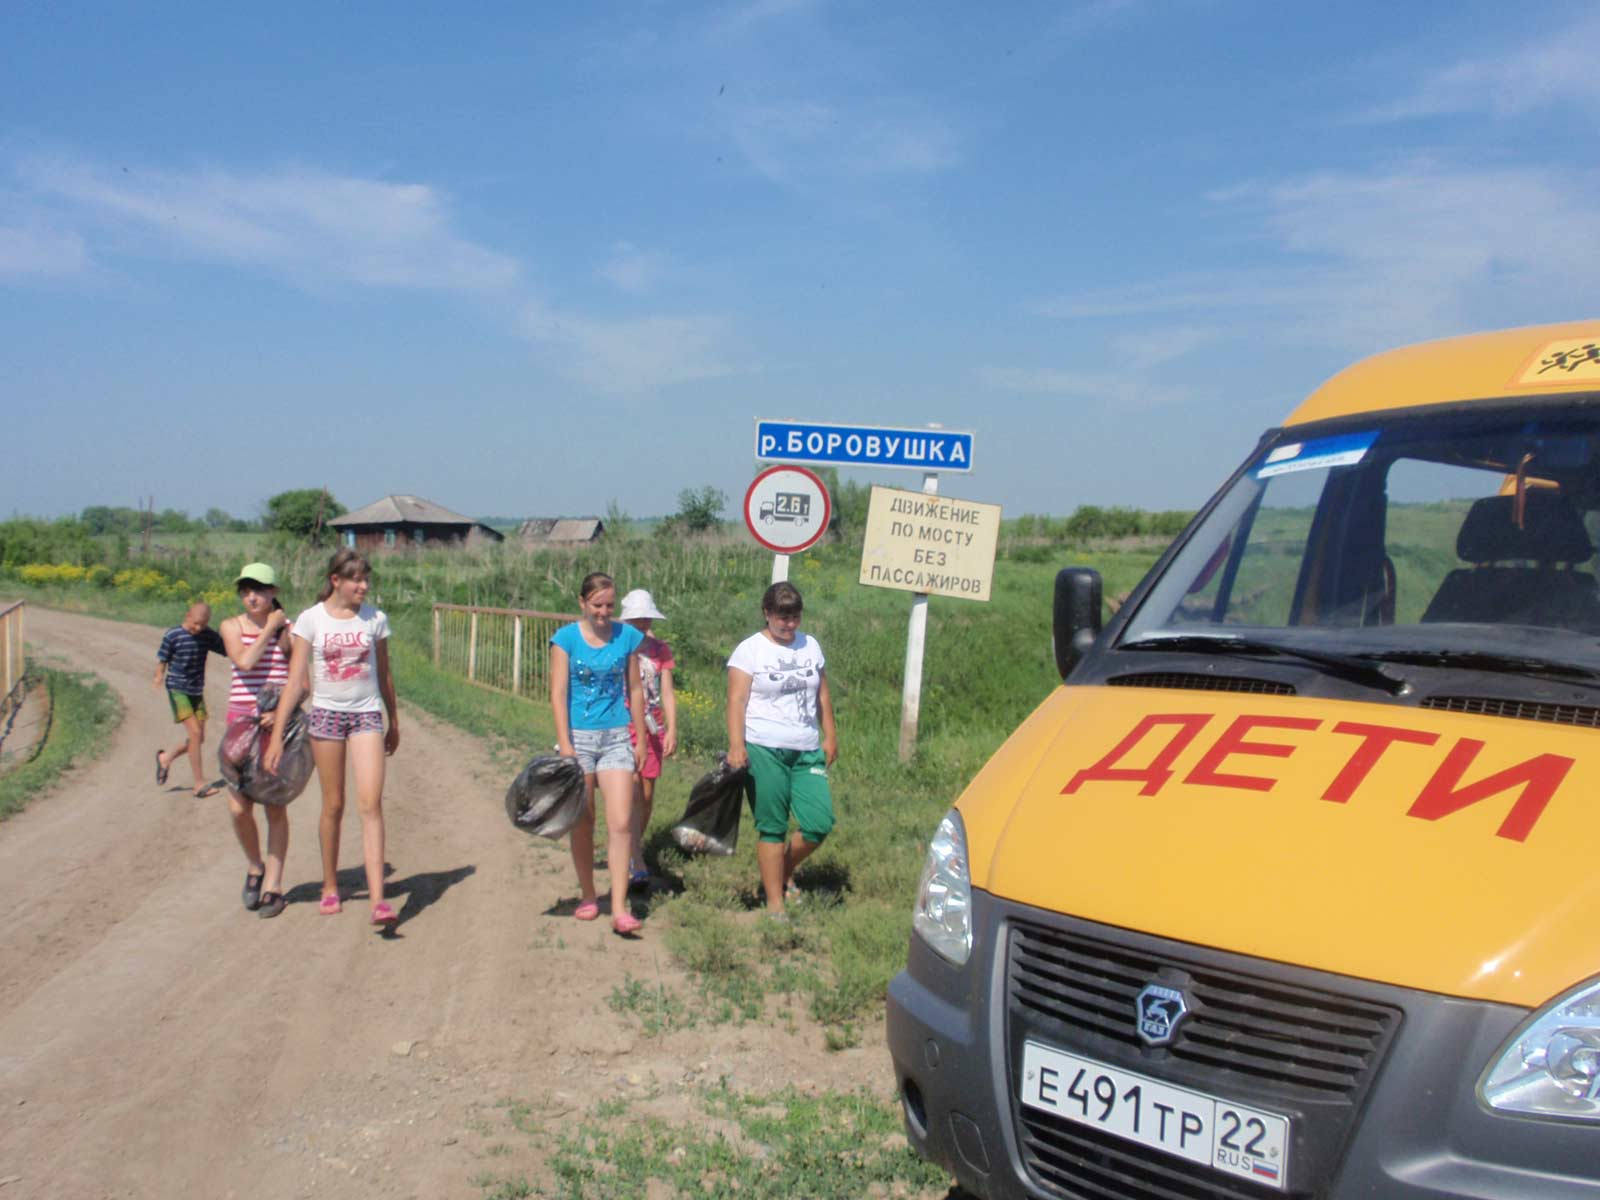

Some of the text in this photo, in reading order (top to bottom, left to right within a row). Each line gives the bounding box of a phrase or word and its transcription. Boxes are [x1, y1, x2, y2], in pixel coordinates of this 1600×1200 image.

[890, 497, 981, 526] ДВИЖЕНИЕ
[891, 521, 974, 547] ПО МОСТУ
[913, 549, 947, 567] БЕЗ
[870, 565, 982, 594] ПАССАЖИРОВ
[1059, 713, 1576, 843] ДЕТИ
[1220, 1110, 1267, 1159] 22
[1217, 1148, 1251, 1171] RUS
